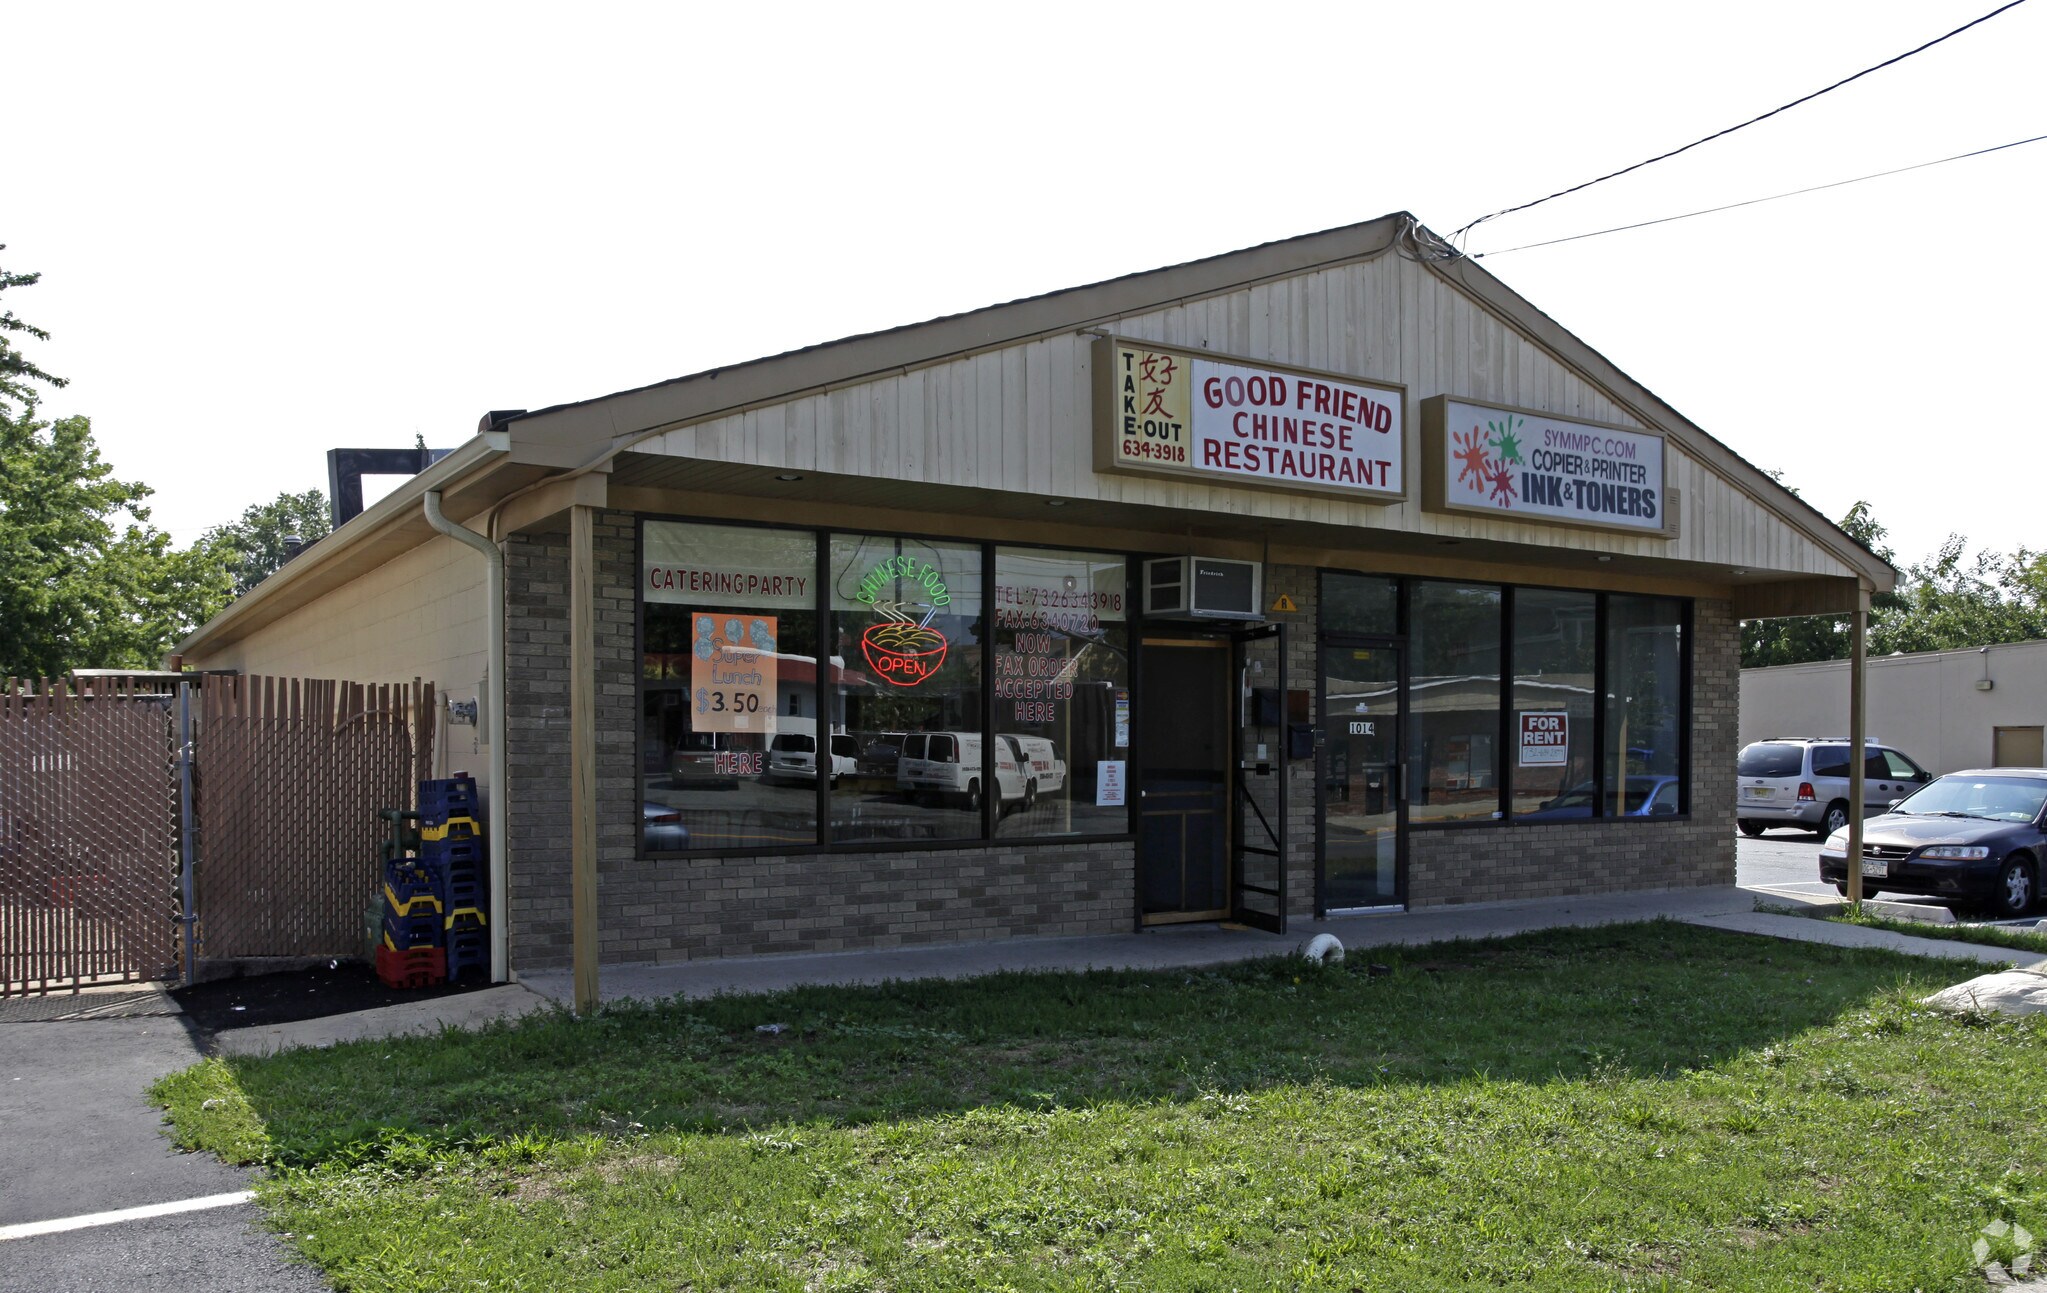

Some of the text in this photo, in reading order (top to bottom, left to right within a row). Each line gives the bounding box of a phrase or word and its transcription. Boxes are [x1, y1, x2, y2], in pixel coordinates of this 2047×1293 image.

[1203, 376, 1392, 434] GOOD FRIEND
[1233, 411, 1353, 452] CHINESE
[1123, 439, 1185, 462] 634-3918
[1544, 429, 1636, 460] SYMMPC.COM
[1203, 438, 1392, 487] RESTAURANT
[856, 556, 951, 606] CHINESE FOOD
[1015, 633, 1051, 654] NOW
[712, 664, 762, 686] Lunch
[878, 656, 926, 676] OPEN
[995, 656, 1079, 678] FAX ORDER
[995, 678, 1073, 700] ACCEPTED
[1015, 701, 1055, 721] HERE
[1351, 723, 1374, 734] 1014
[1528, 717, 1559, 730] FOR
[1523, 731, 1565, 745] RENT
[714, 752, 763, 775] HERE
